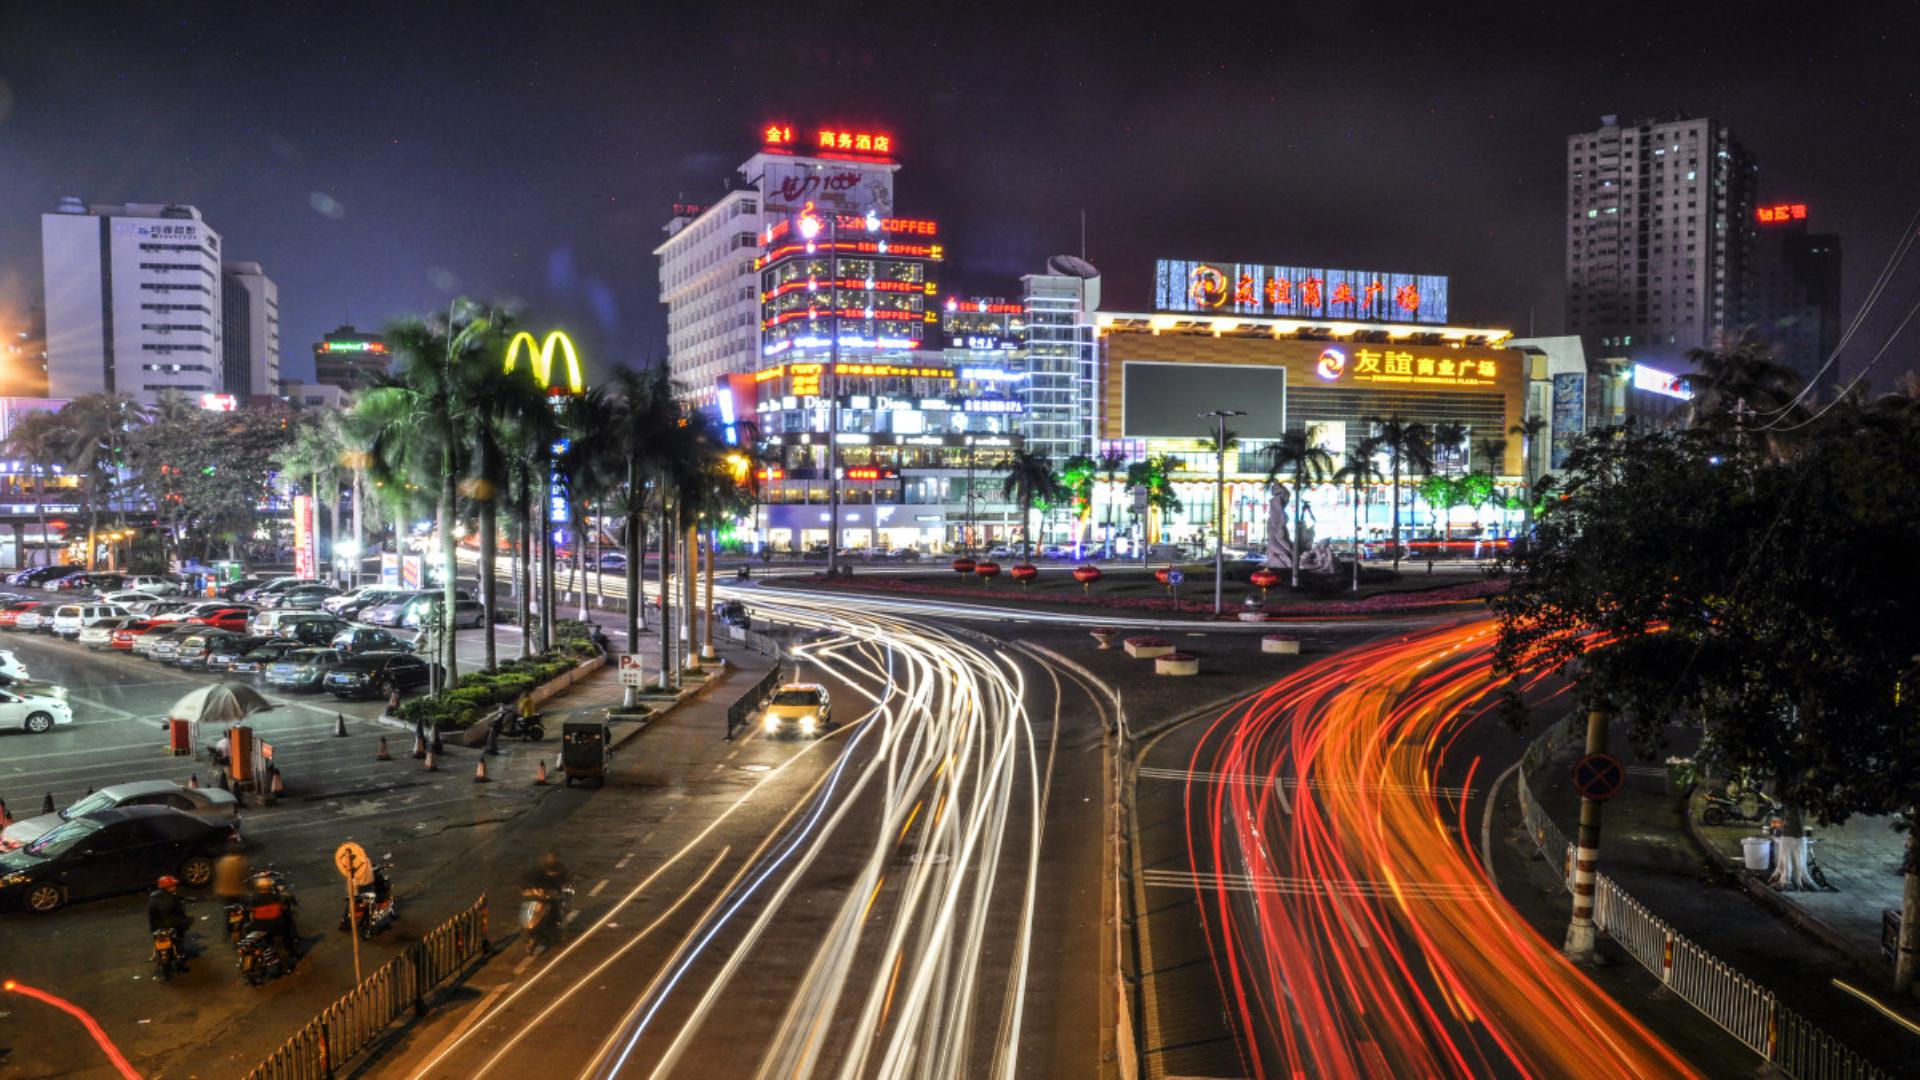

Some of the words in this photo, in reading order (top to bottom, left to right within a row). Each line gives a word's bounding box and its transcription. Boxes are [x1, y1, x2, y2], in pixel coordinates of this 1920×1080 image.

[819, 130, 889, 152] 商务酒店
[881, 218, 937, 235] COFFEE
[888, 244, 924, 255] COFFEE
[845, 279, 865, 290] SEN
[874, 281, 911, 292] COFFEE
[959, 302, 979, 312] SEN
[987, 304, 1023, 314] COFFEE
[874, 310, 911, 321] COFFEE
